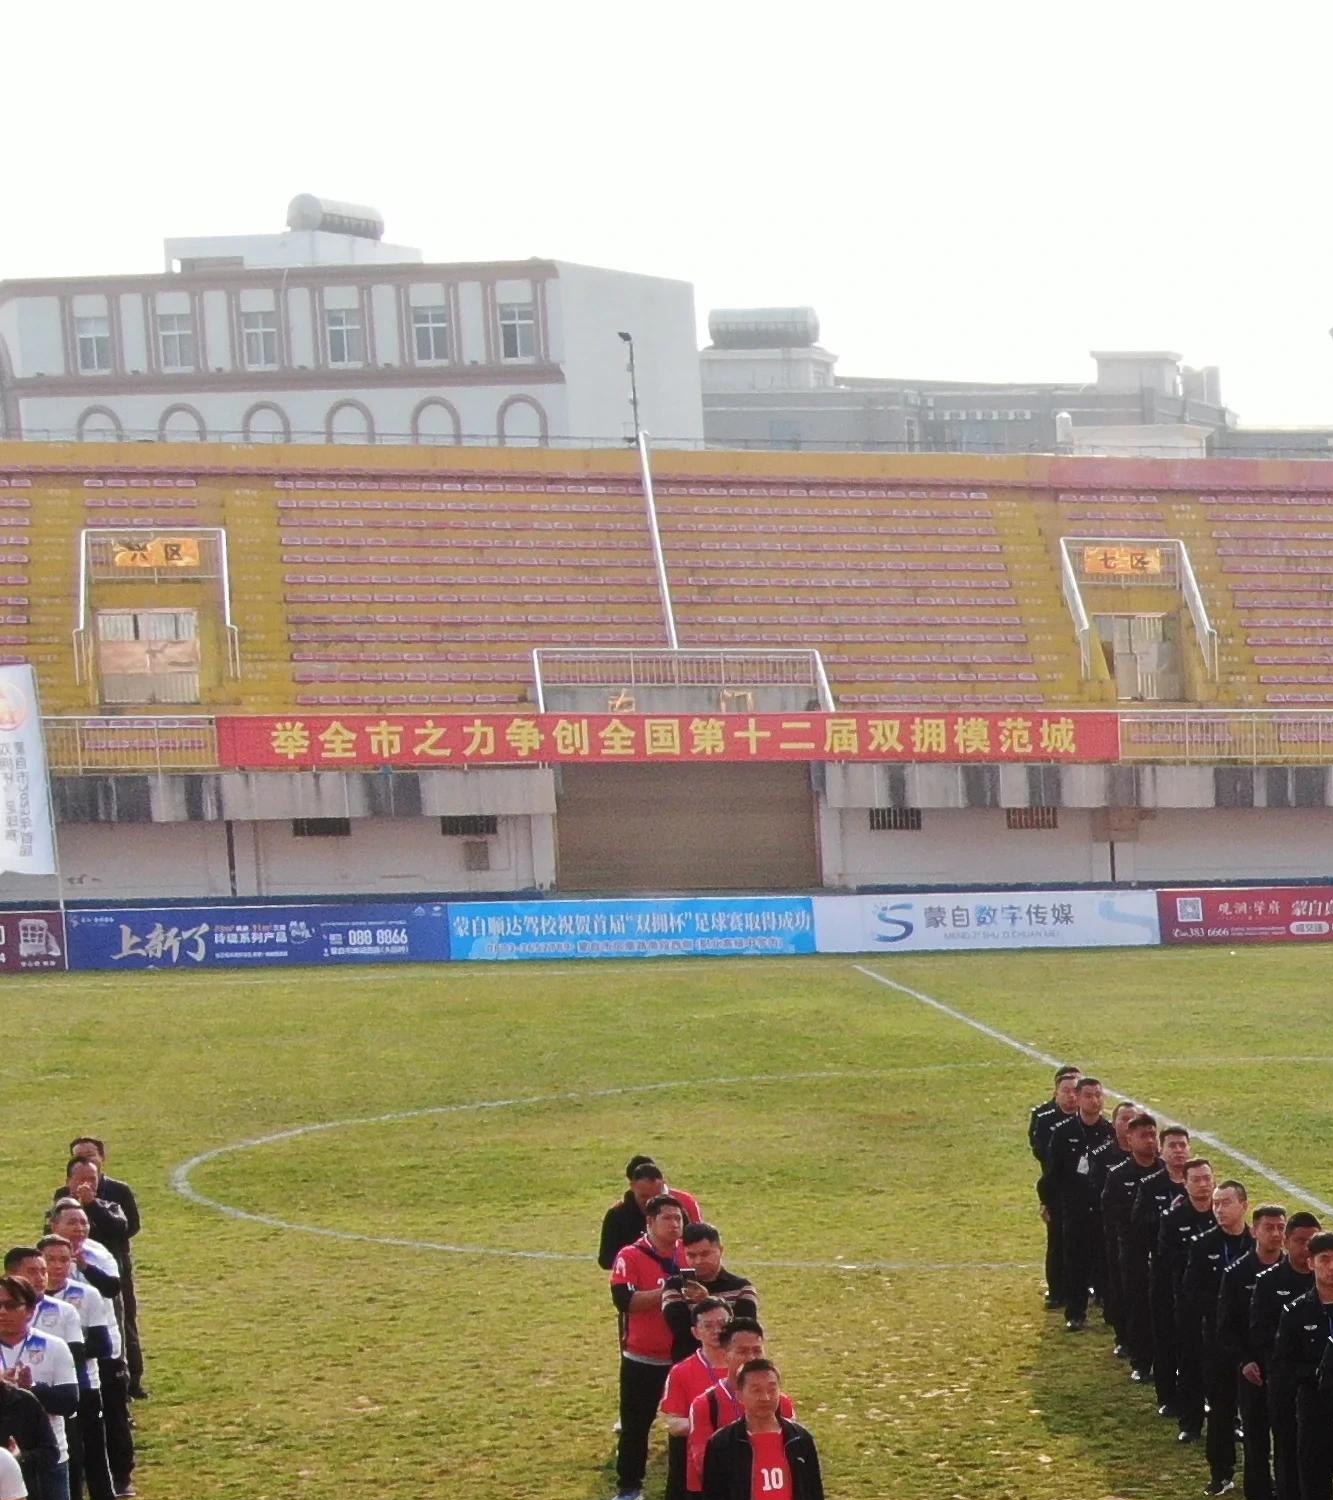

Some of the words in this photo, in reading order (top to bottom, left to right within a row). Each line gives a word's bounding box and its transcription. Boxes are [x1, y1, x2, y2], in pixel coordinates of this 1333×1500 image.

[1099, 551, 1150, 570] 七区
[271, 717, 1077, 760] 举全市之力争创全国第十二届双拥模范城
[924, 902, 1075, 929] 蒙自数字传媒
[111, 922, 210, 963] 上新了
[760, 1467, 784, 1491] 10
